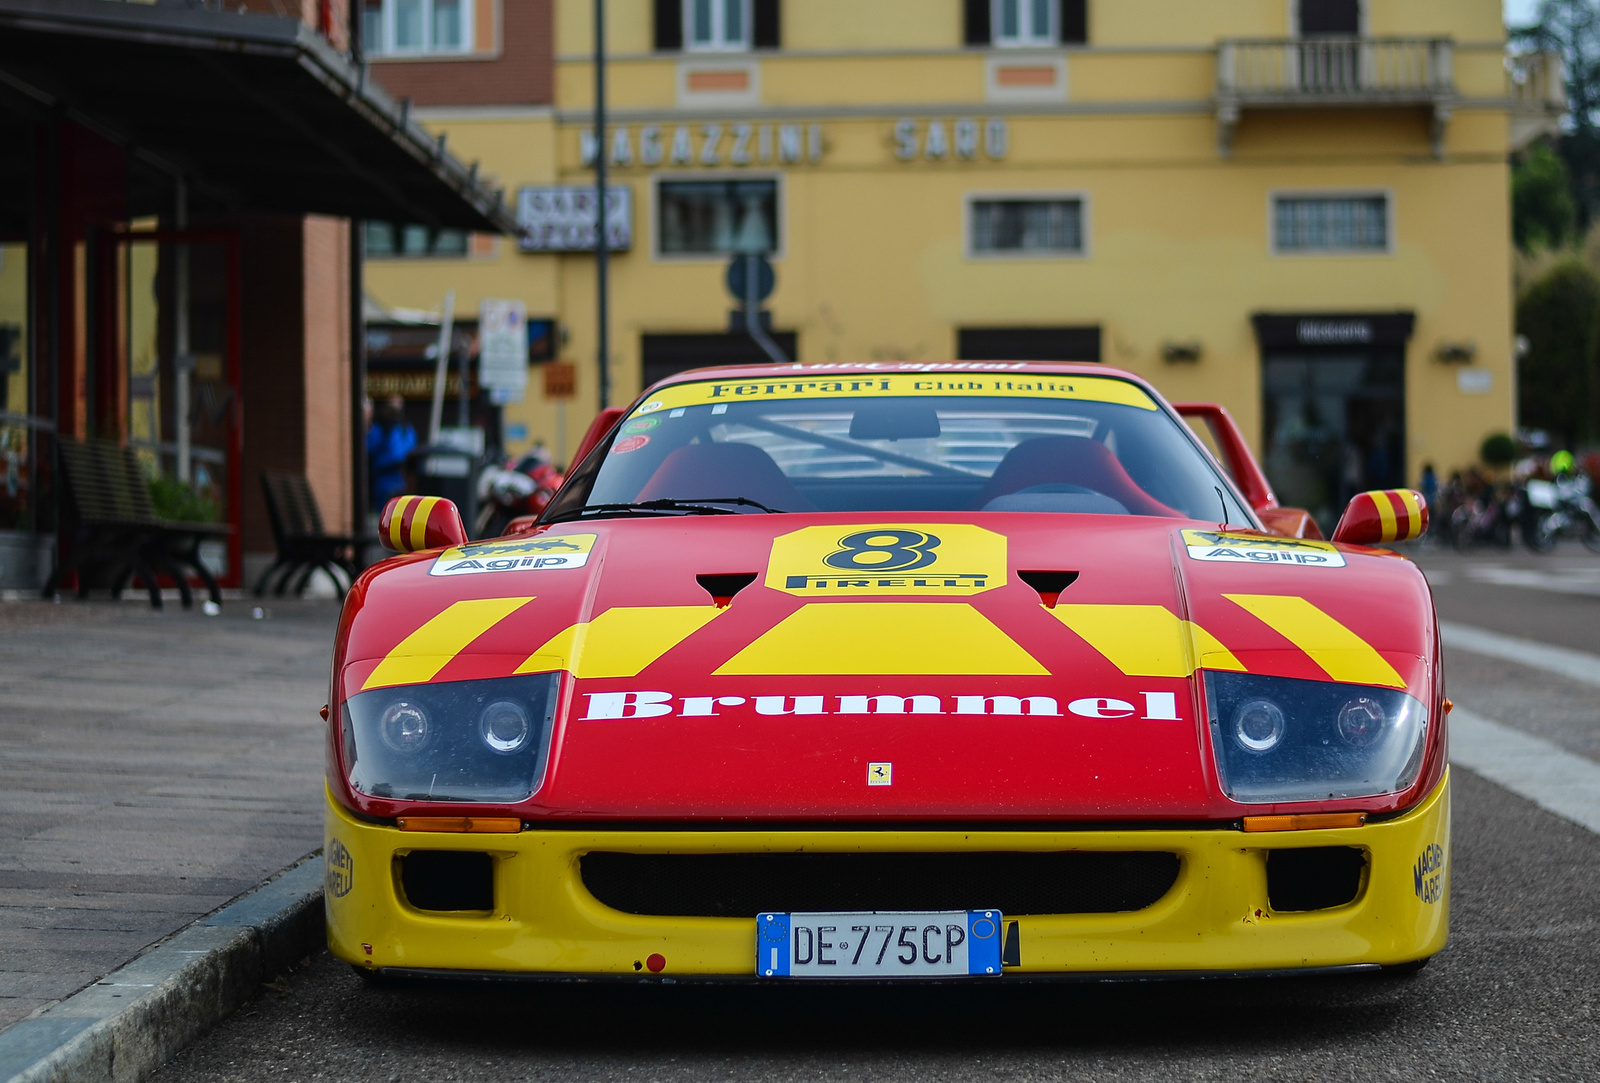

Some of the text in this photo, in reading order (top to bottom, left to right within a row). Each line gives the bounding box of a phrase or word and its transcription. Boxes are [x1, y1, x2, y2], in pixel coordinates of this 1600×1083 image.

[580, 117, 1010, 166] MAGAZZINI SARO
[707, 378, 1075, 398] Ferrari Club Italia
[822, 528, 942, 572] 8
[1205, 548, 1327, 564] Agip
[444, 556, 568, 571] Agip
[785, 573, 989, 589] PIRELLI
[577, 690, 1184, 721] Brummel
[794, 925, 966, 965] DE 775CP
